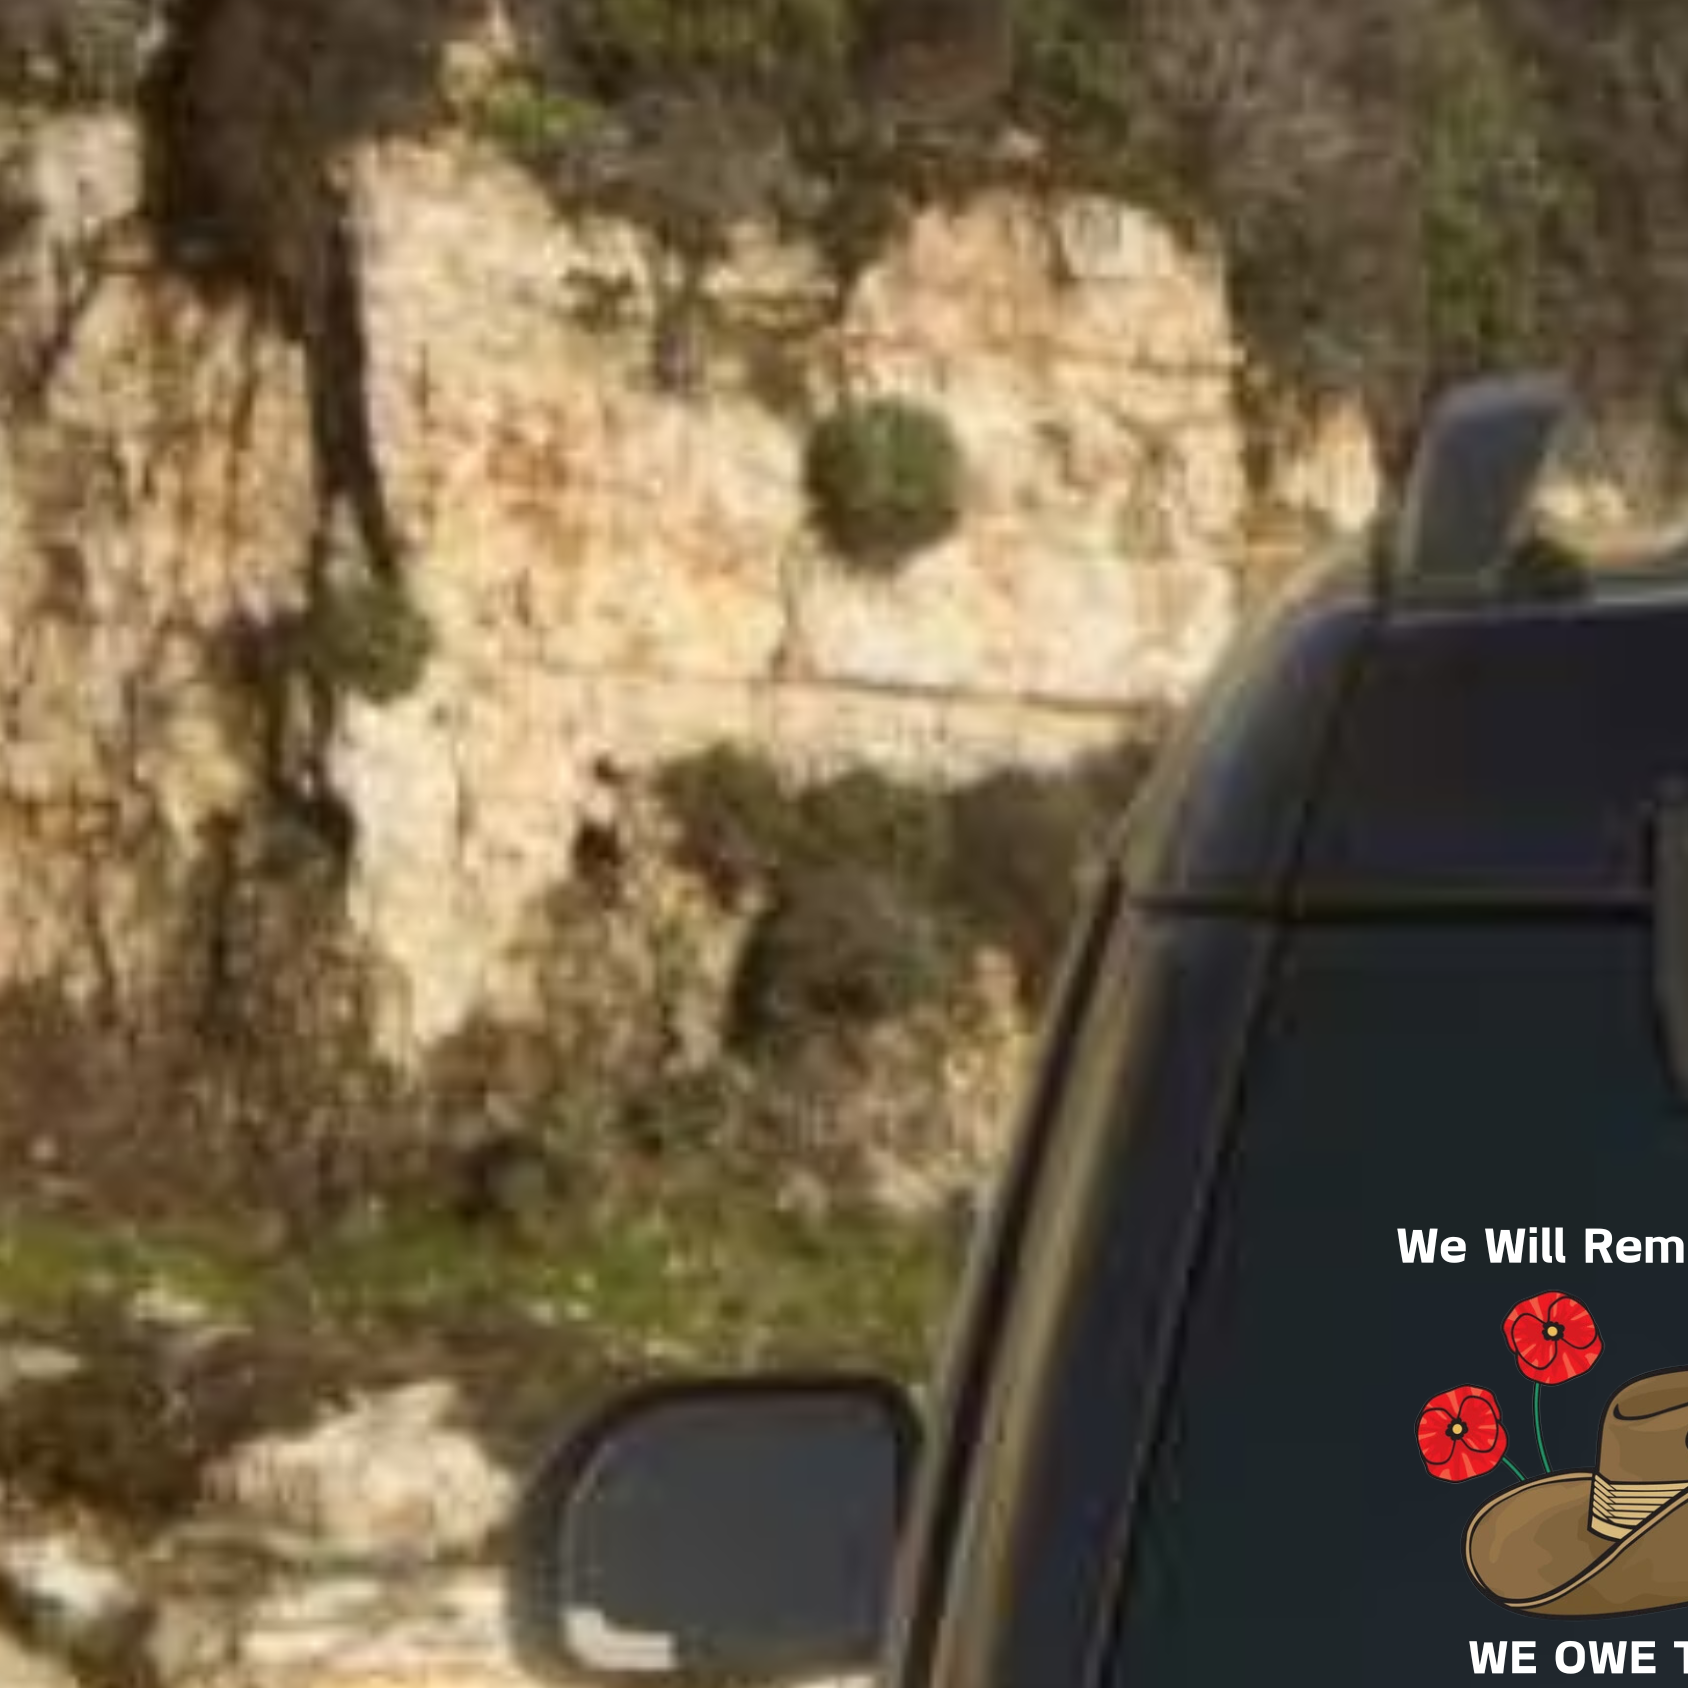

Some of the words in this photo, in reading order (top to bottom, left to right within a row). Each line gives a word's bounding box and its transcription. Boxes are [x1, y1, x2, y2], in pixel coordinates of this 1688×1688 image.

[1396, 1227, 1467, 1264] We
[1484, 1226, 1566, 1264] Will
[1468, 1640, 1537, 1675] WE
[1554, 1640, 1657, 1675] OWE
